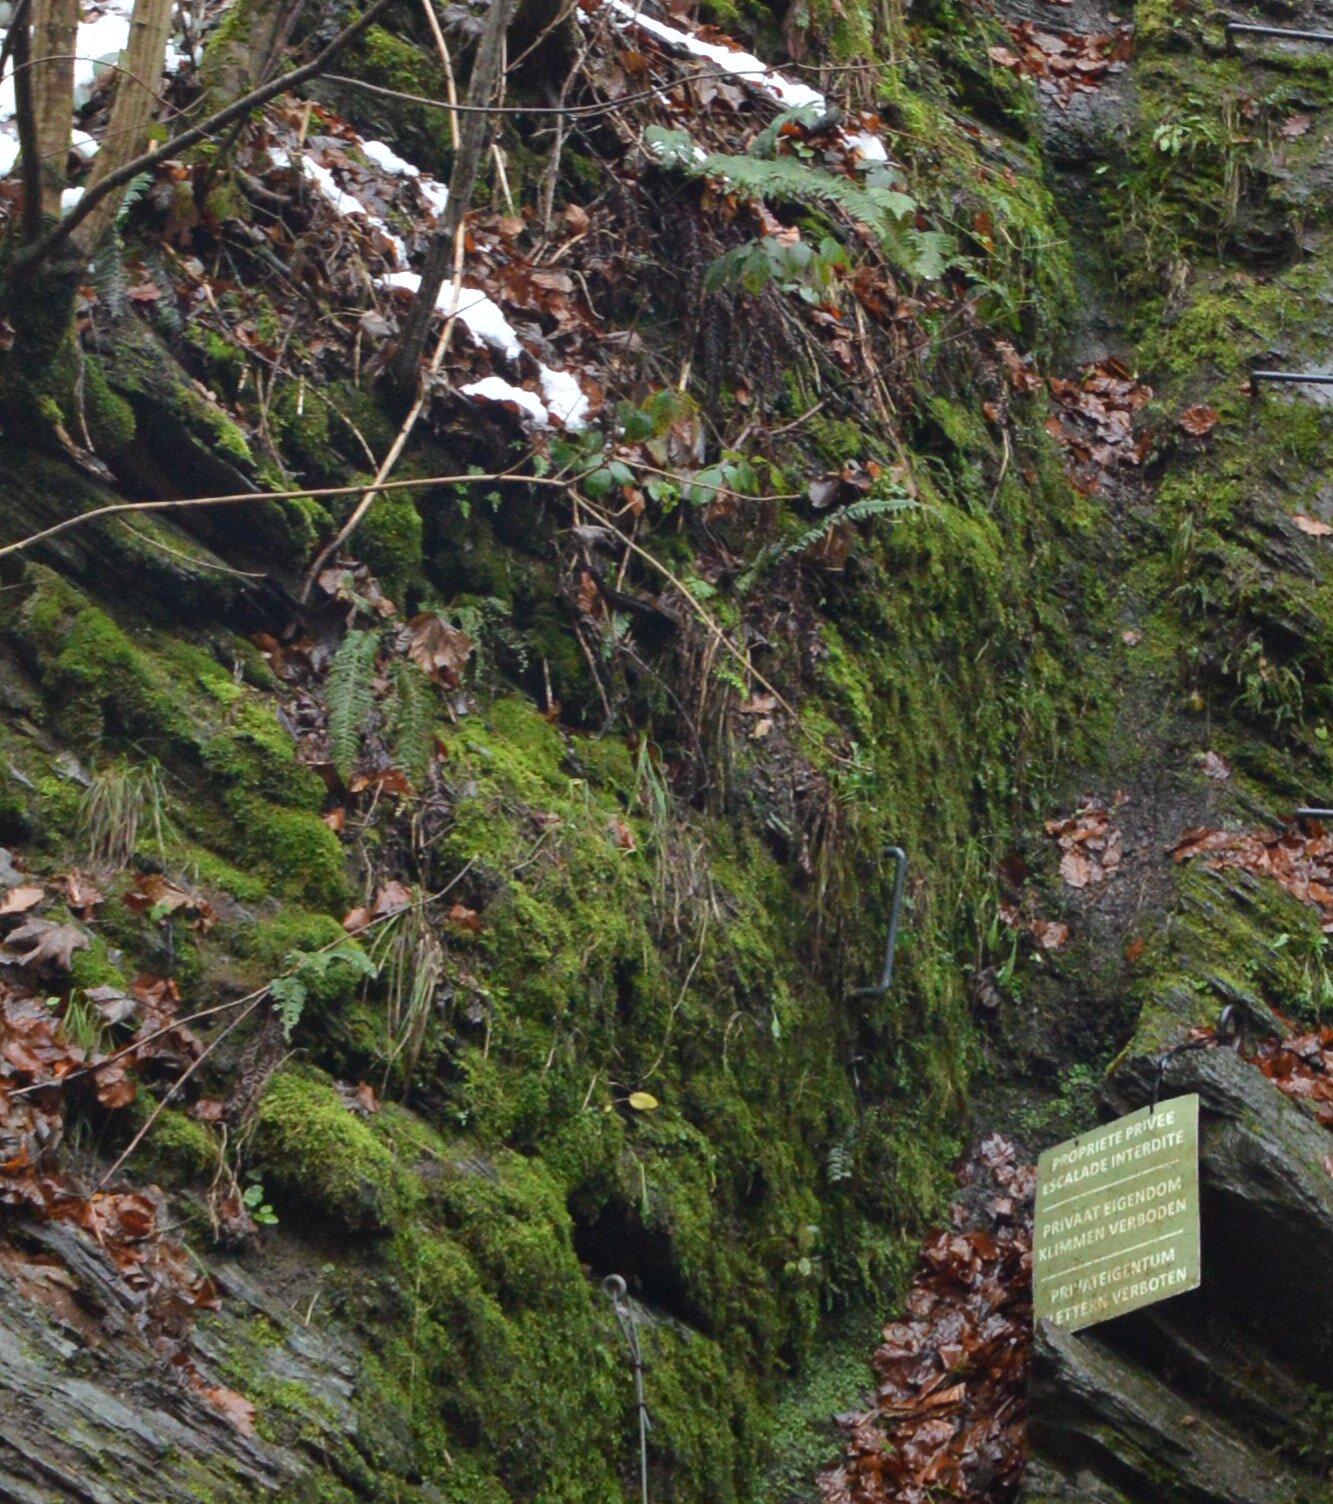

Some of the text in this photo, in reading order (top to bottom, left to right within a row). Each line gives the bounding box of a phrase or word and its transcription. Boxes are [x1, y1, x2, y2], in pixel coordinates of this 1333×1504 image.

[1042, 1129, 1184, 1196] ESCALADE INTERDITE
[1052, 1111, 1175, 1171] PROPRIETE PRIVEE
[1038, 1198, 1187, 1262] KLIMMEN VERBODEN
[1043, 1176, 1181, 1238] PRIVAAT EIGENDOM
[1112, 1267, 1187, 1305] VERBOTEN
